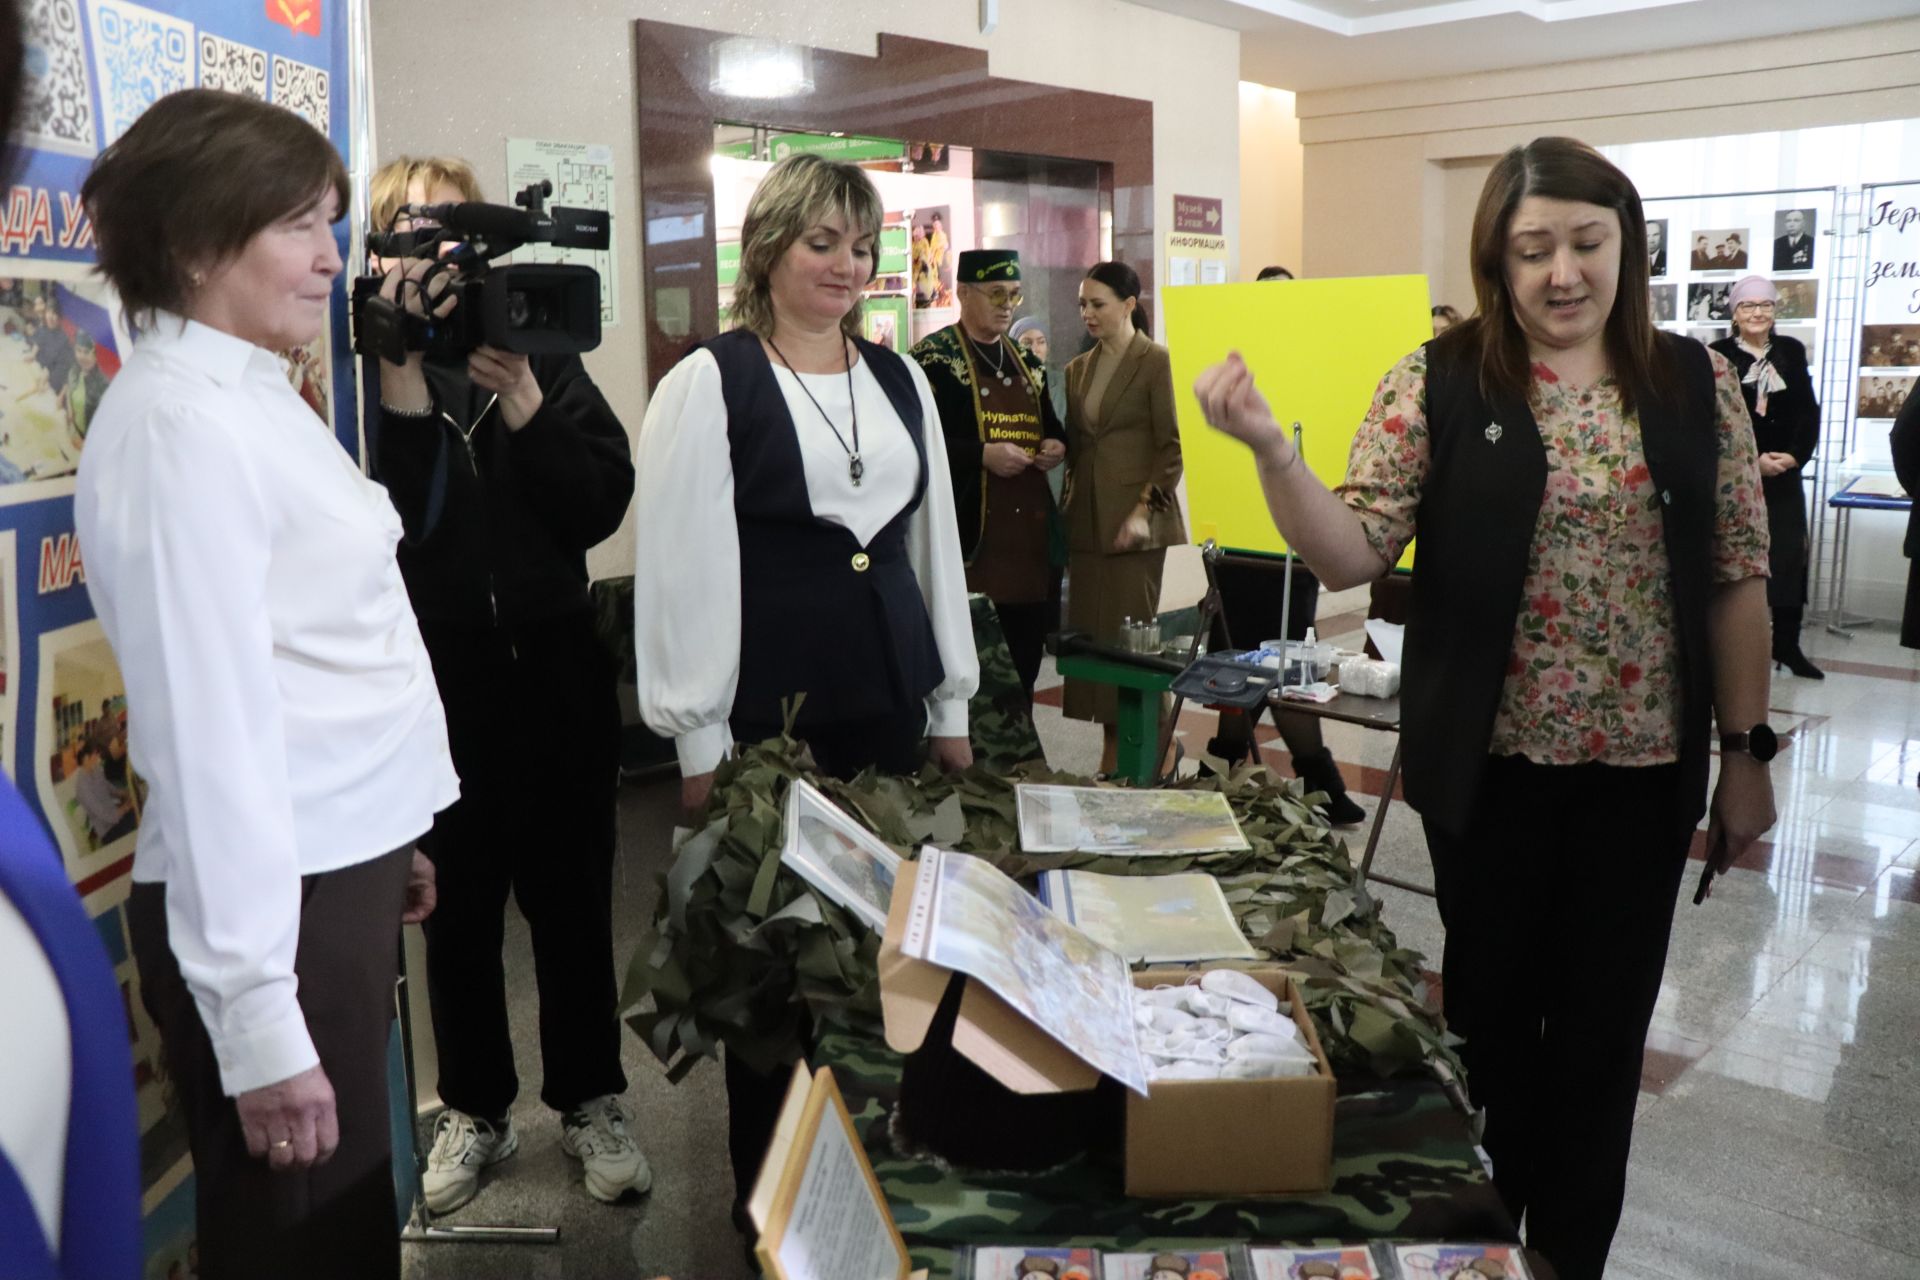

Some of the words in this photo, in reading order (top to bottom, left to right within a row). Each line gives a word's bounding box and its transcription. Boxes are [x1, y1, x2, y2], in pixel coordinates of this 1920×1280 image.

[0, 185, 54, 255] ДА
[1177, 201, 1203, 215] Музей
[1868, 200, 1920, 234] Гер
[1170, 236, 1225, 251] ИНФОРМАЦИЯ
[1865, 261, 1920, 288] зем
